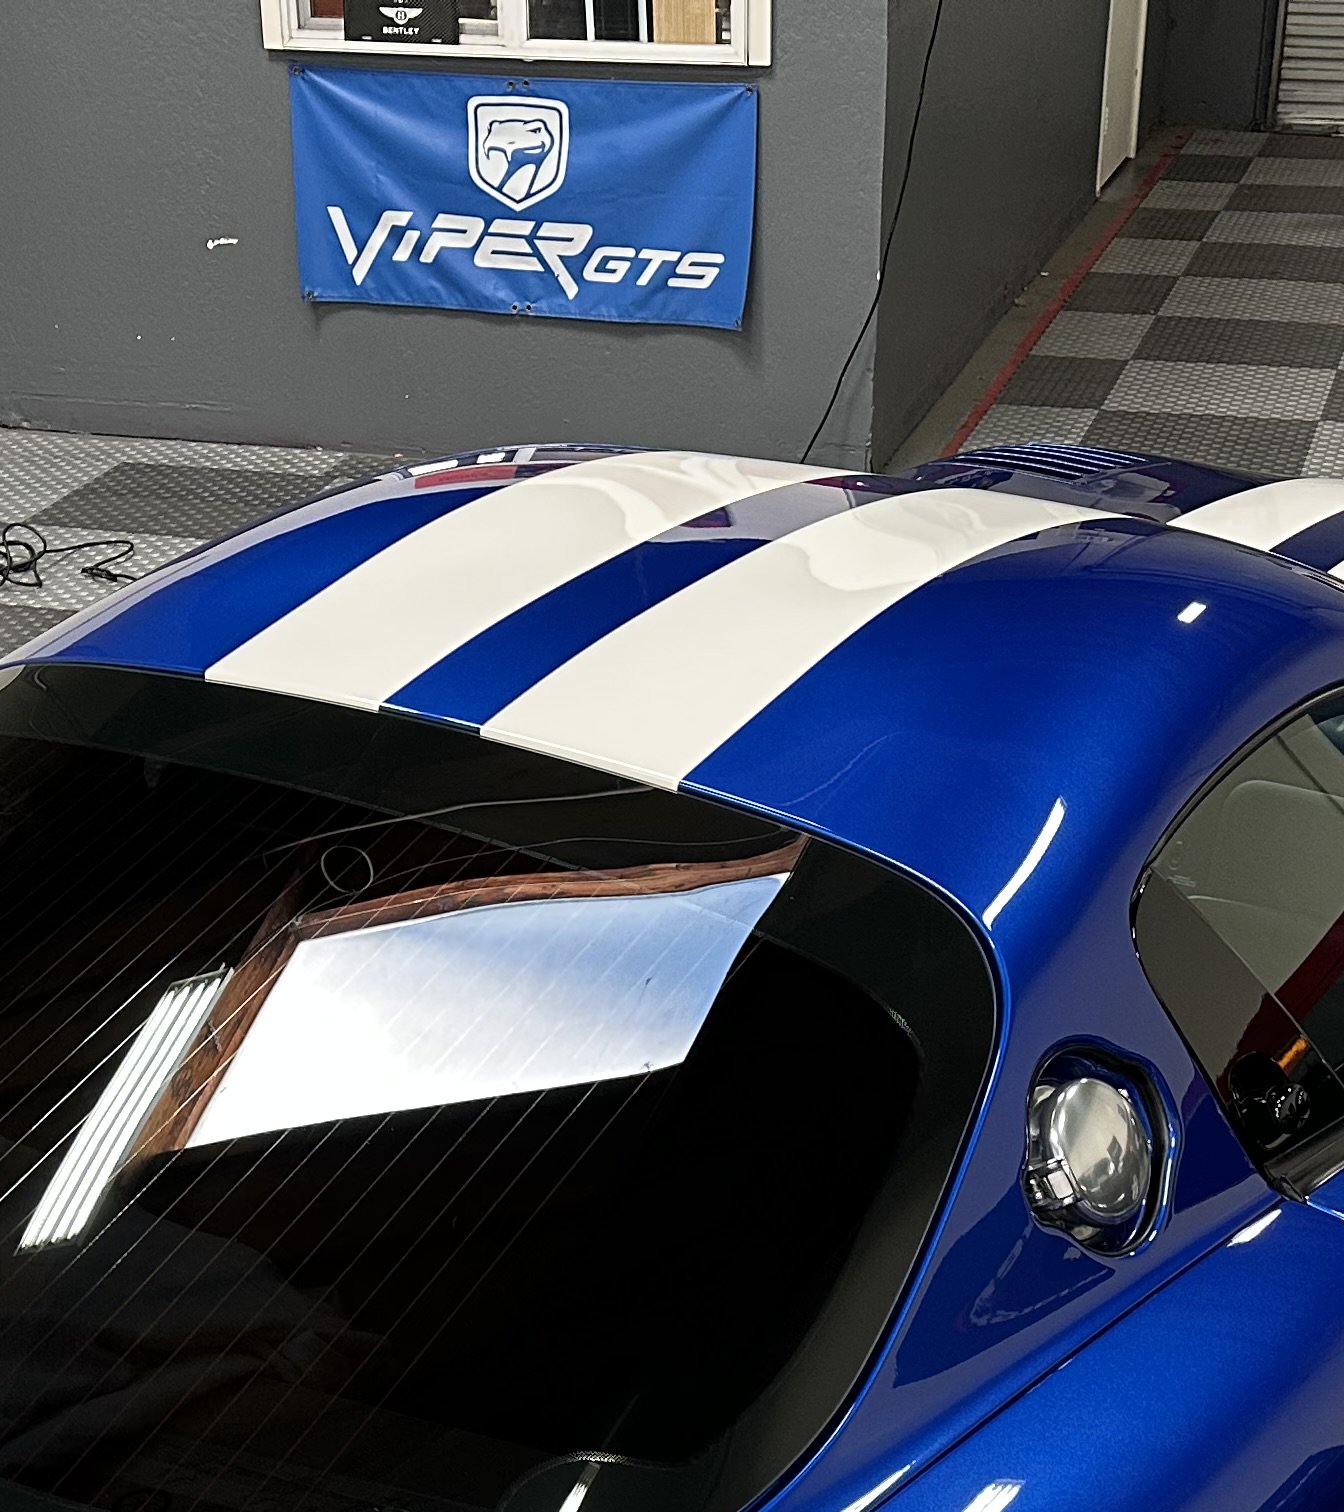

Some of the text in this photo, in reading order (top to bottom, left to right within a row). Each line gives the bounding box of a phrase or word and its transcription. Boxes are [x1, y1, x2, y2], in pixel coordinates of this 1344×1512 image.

[382, 26, 420, 35] BENTLEY
[327, 205, 725, 300] VIPER GTS
